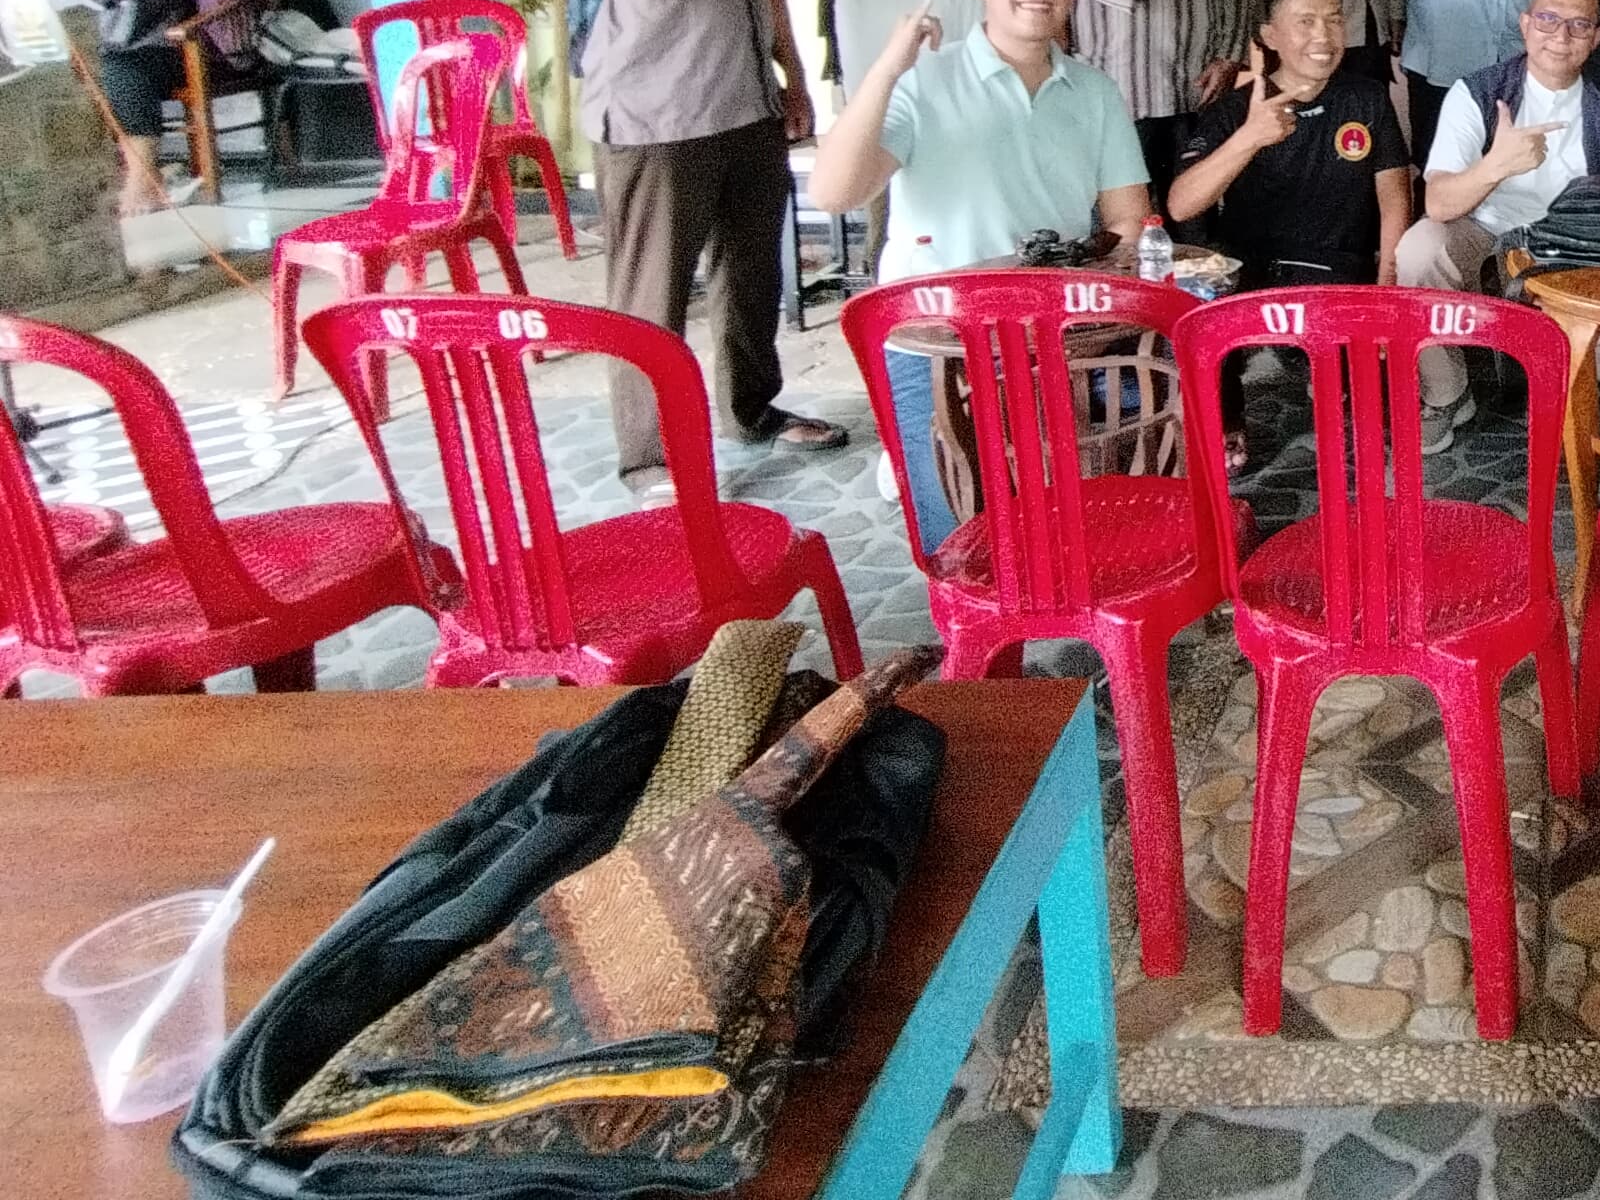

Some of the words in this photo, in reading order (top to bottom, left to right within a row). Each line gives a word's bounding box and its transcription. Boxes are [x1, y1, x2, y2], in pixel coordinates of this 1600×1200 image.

[911, 285, 954, 317] 07
[379, 307, 418, 341] 07
[497, 308, 549, 340] 06
[1260, 302, 1306, 335] 07
